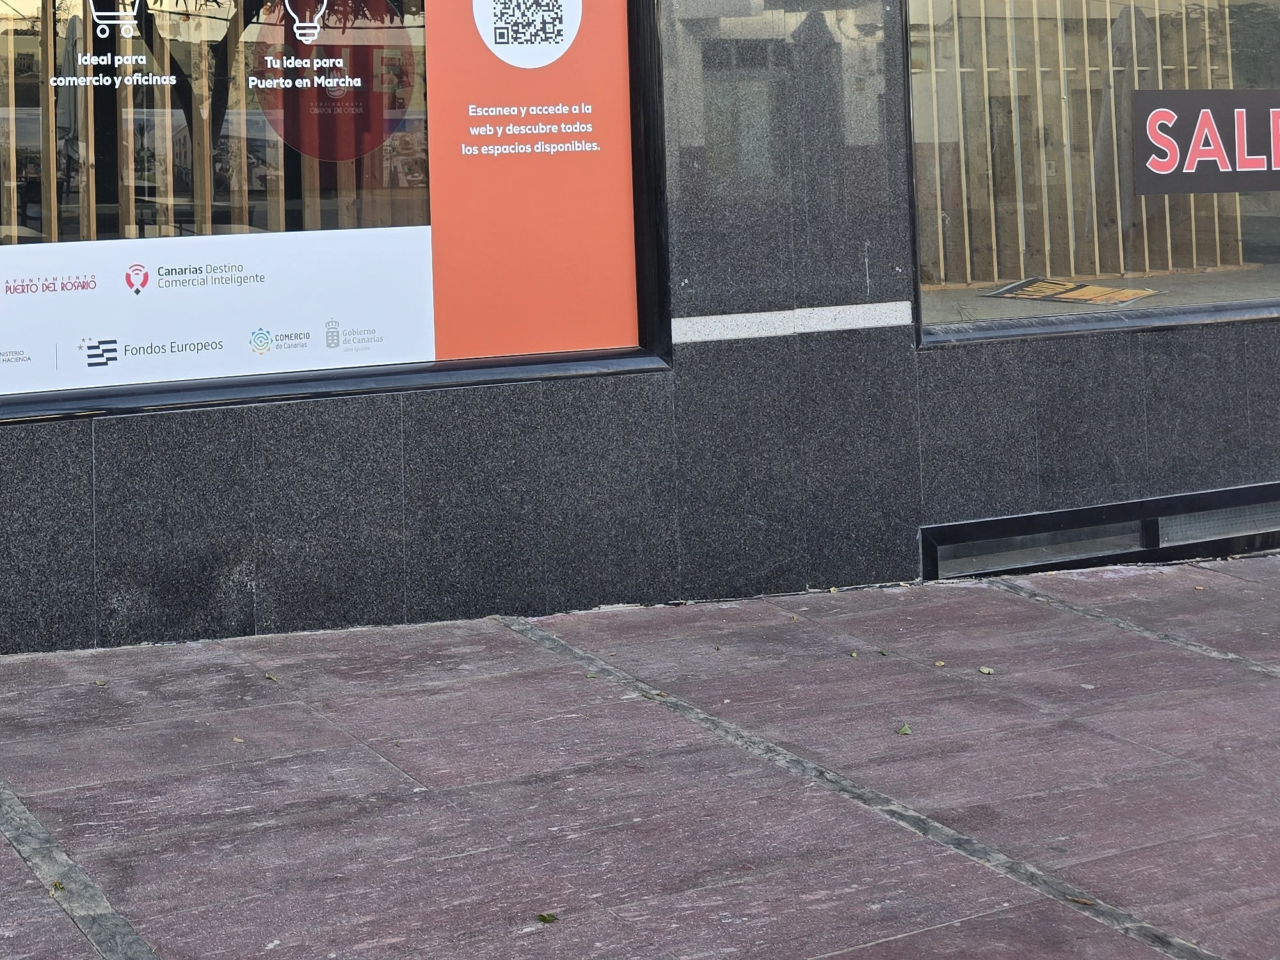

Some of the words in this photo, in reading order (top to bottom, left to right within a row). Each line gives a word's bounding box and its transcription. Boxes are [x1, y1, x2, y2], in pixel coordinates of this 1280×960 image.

[77, 53, 112, 66] Ideal
[114, 54, 147, 68] para
[264, 56, 280, 68] Tu
[282, 56, 311, 68] idea
[313, 58, 344, 70] para
[49, 73, 112, 87] comercio
[114, 76, 121, 88] y
[123, 72, 177, 86] oficinas
[248, 76, 293, 90] Puerto
[295, 78, 311, 88] en
[314, 76, 362, 87] Marcha
[468, 104, 518, 116] Escanea
[519, 106, 527, 118] y
[529, 103, 569, 115] accede
[571, 105, 579, 114] a
[581, 103, 592, 114] la
[469, 124, 494, 135] web
[496, 126, 504, 137] y
[505, 123, 558, 135] descubre
[561, 122, 593, 133] todos
[461, 143, 478, 155] los
[481, 142, 532, 156] espacios
[534, 140, 601, 155] disponibles.
[157, 266, 203, 277] Canarias
[205, 263, 244, 274] Destino
[5, 274, 96, 284] AYUNTAMIENTO
[158, 275, 208, 288] Comercial
[210, 272, 266, 287] Inteligente
[6, 283, 39, 295] PUERTO
[42, 282, 58, 292] DEL
[61, 280, 96, 292] ROSARIO
[274, 332, 310, 342] COMERCIO
[342, 328, 376, 336] Gobierno
[352, 336, 384, 344] Canarias
[124, 342, 167, 357] Fondos
[170, 340, 224, 355] Europeos
[2, 355, 32, 364] HACIENDA
